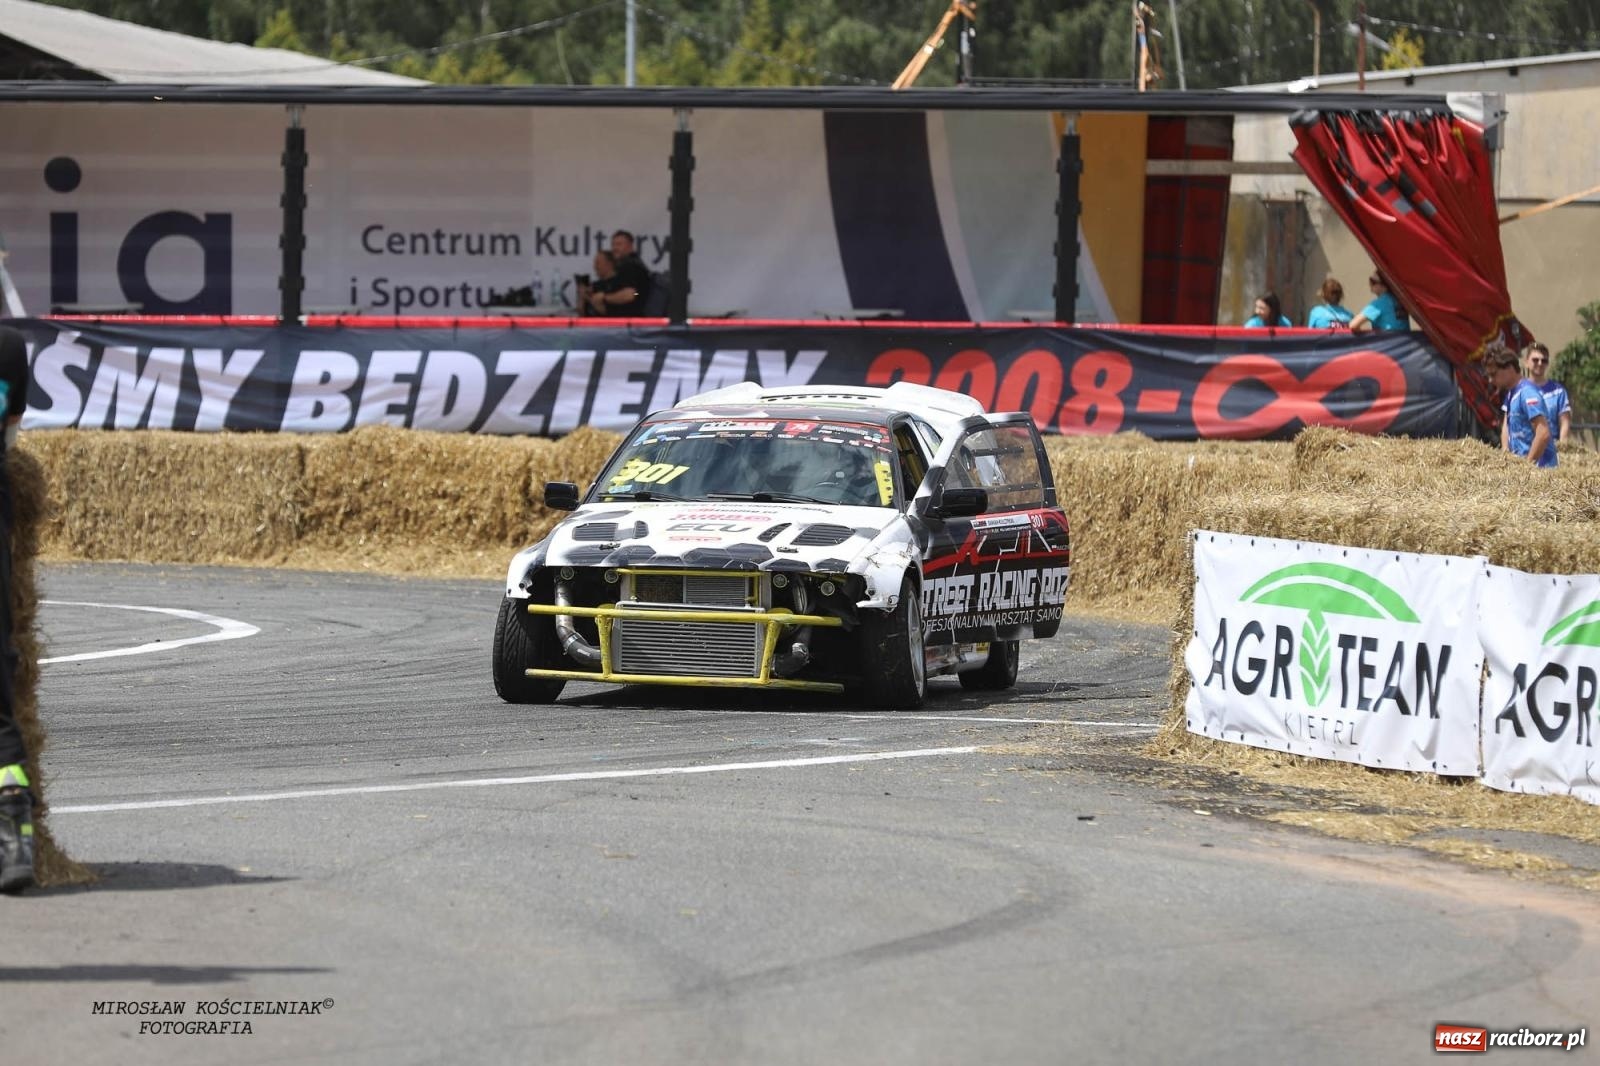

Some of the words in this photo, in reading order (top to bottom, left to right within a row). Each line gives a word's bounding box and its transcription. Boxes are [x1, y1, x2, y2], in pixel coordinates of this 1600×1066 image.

[361, 224, 521, 256] Centrum
[535, 225, 670, 265] Kultry
[350, 278, 358, 305] i
[21, 331, 265, 430] ŚMY
[666, 523, 753, 532] ECU
[977, 568, 1037, 612] RACING
[987, 609, 1035, 626] WARSZTAT
